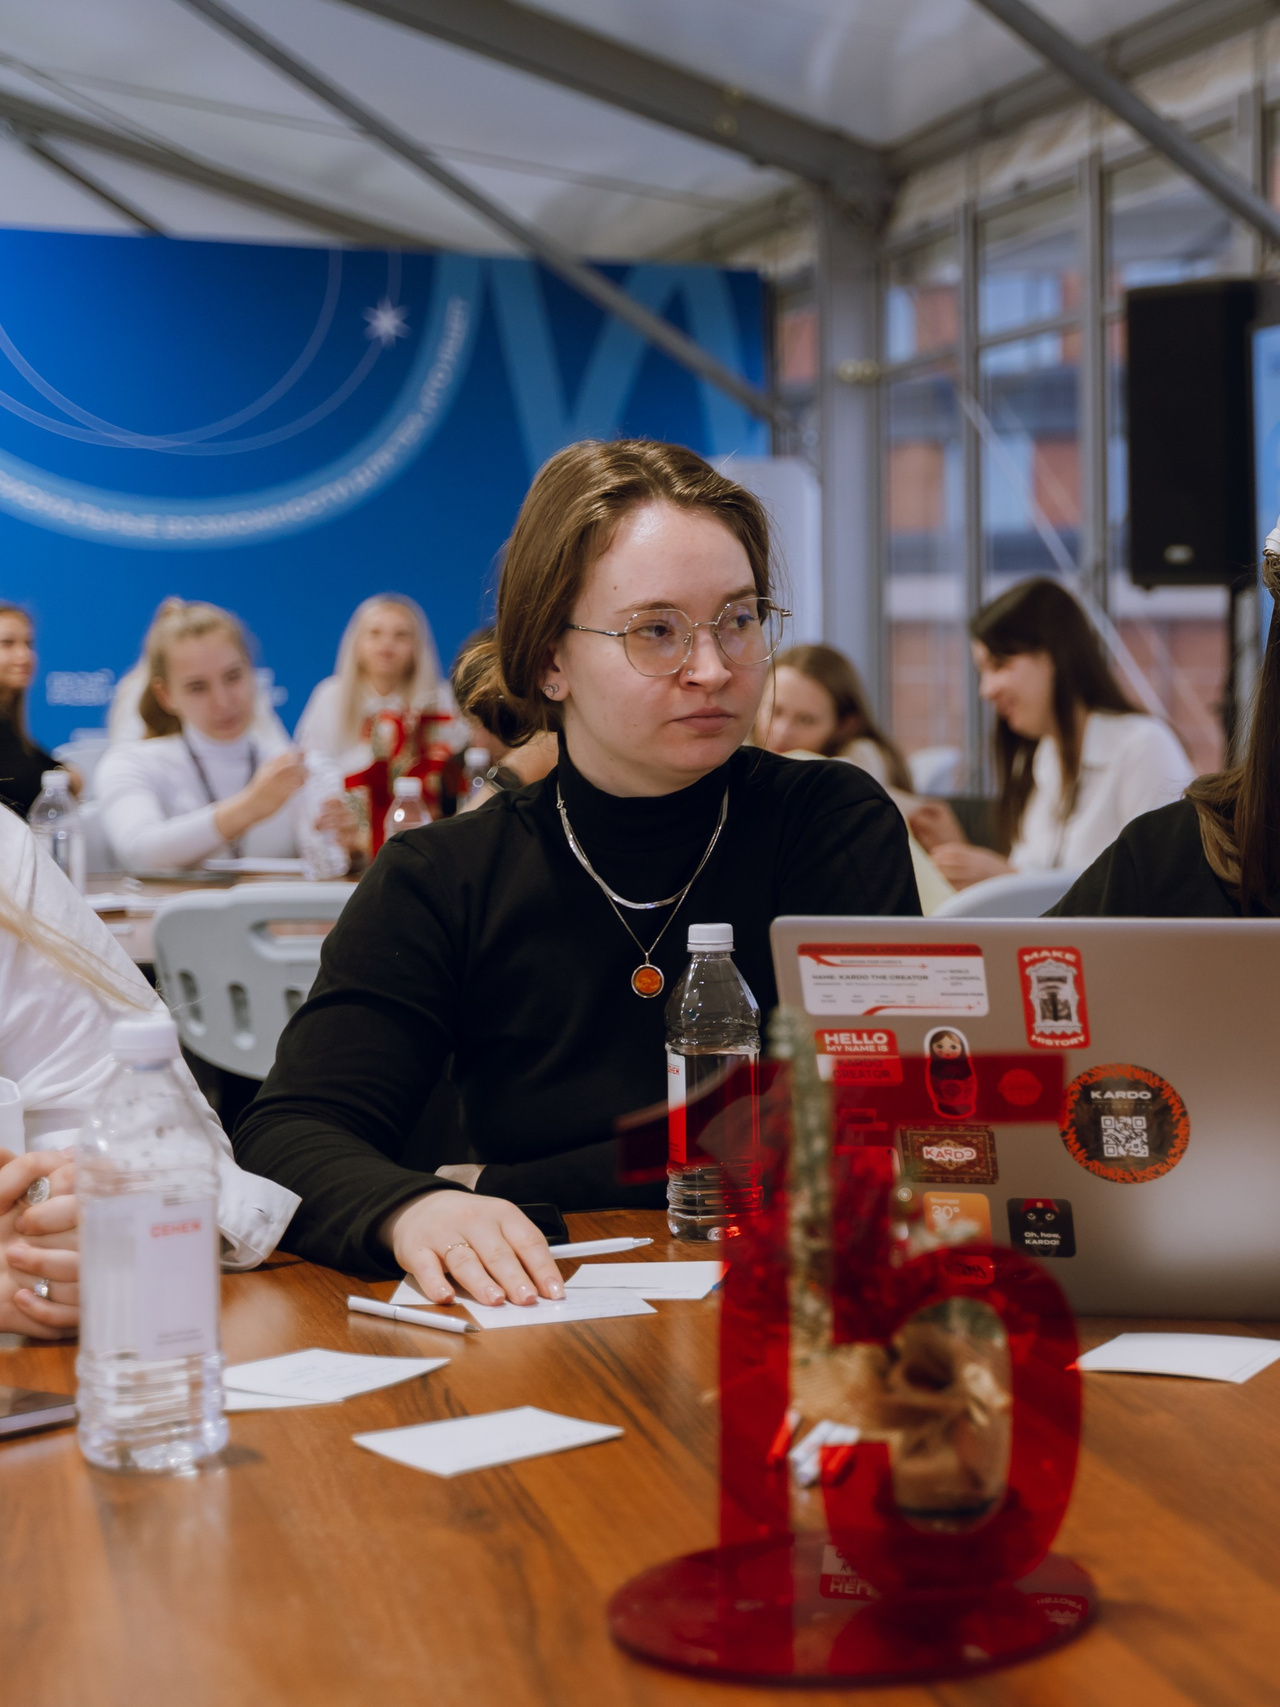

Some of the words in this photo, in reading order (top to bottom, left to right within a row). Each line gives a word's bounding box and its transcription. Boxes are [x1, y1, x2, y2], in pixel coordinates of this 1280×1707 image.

[1023, 950, 1076, 962] MAKE
[824, 1033, 888, 1044] HELLO
[1031, 1034, 1085, 1046] HISTORY
[1091, 1090, 1152, 1099] KARDO
[1040, 1231, 1061, 1239] how,
